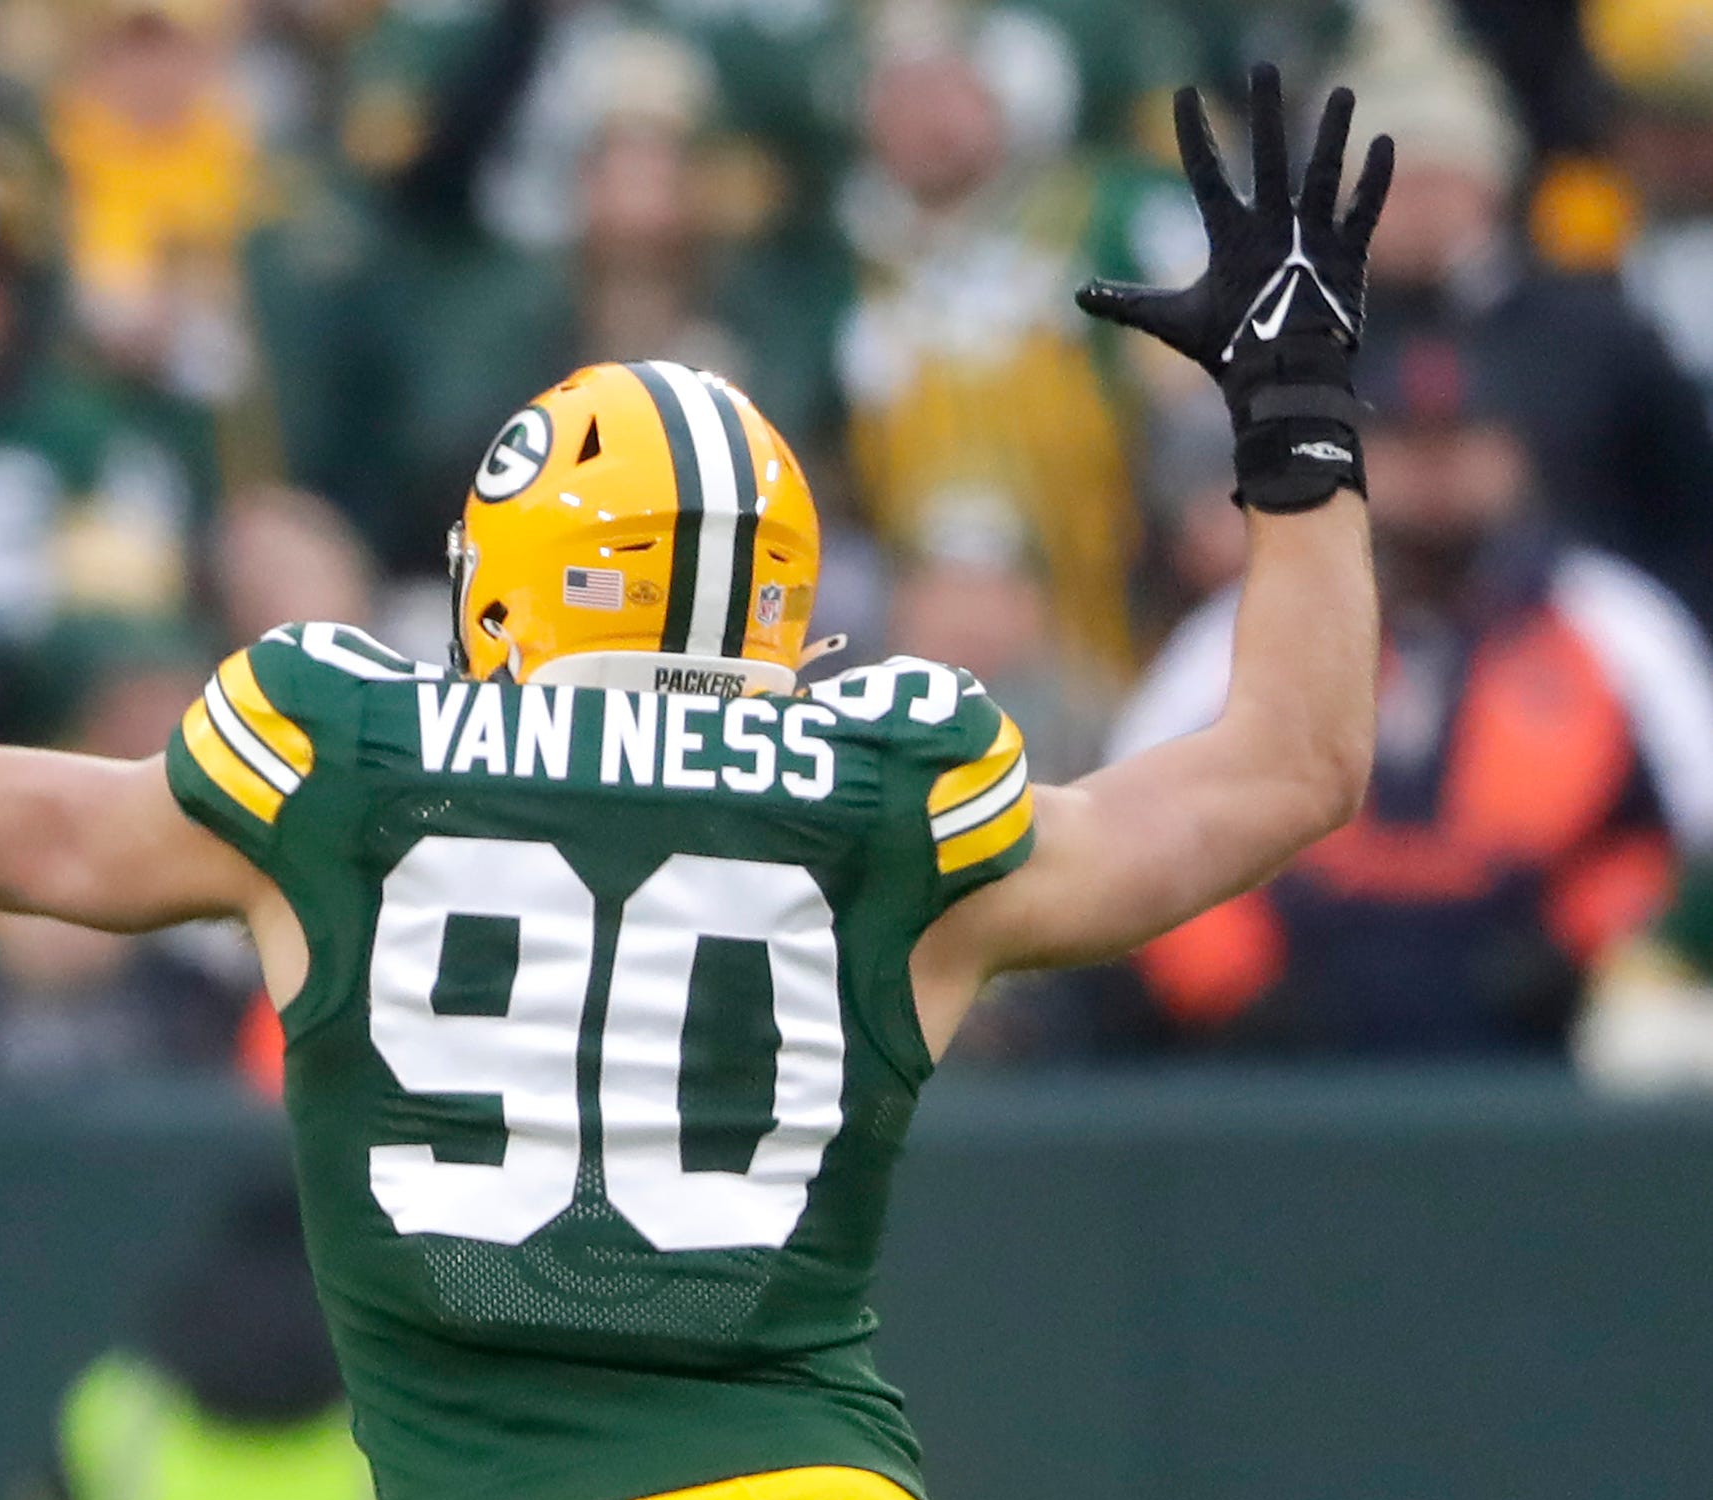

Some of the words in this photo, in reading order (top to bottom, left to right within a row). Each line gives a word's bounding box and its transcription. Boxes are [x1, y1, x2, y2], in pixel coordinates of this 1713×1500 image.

[475, 408, 548, 500] G
[655, 667, 746, 699] PACKERS
[417, 681, 574, 779] VAN
[599, 689, 837, 801] NESS
[369, 835, 845, 1252] 90
